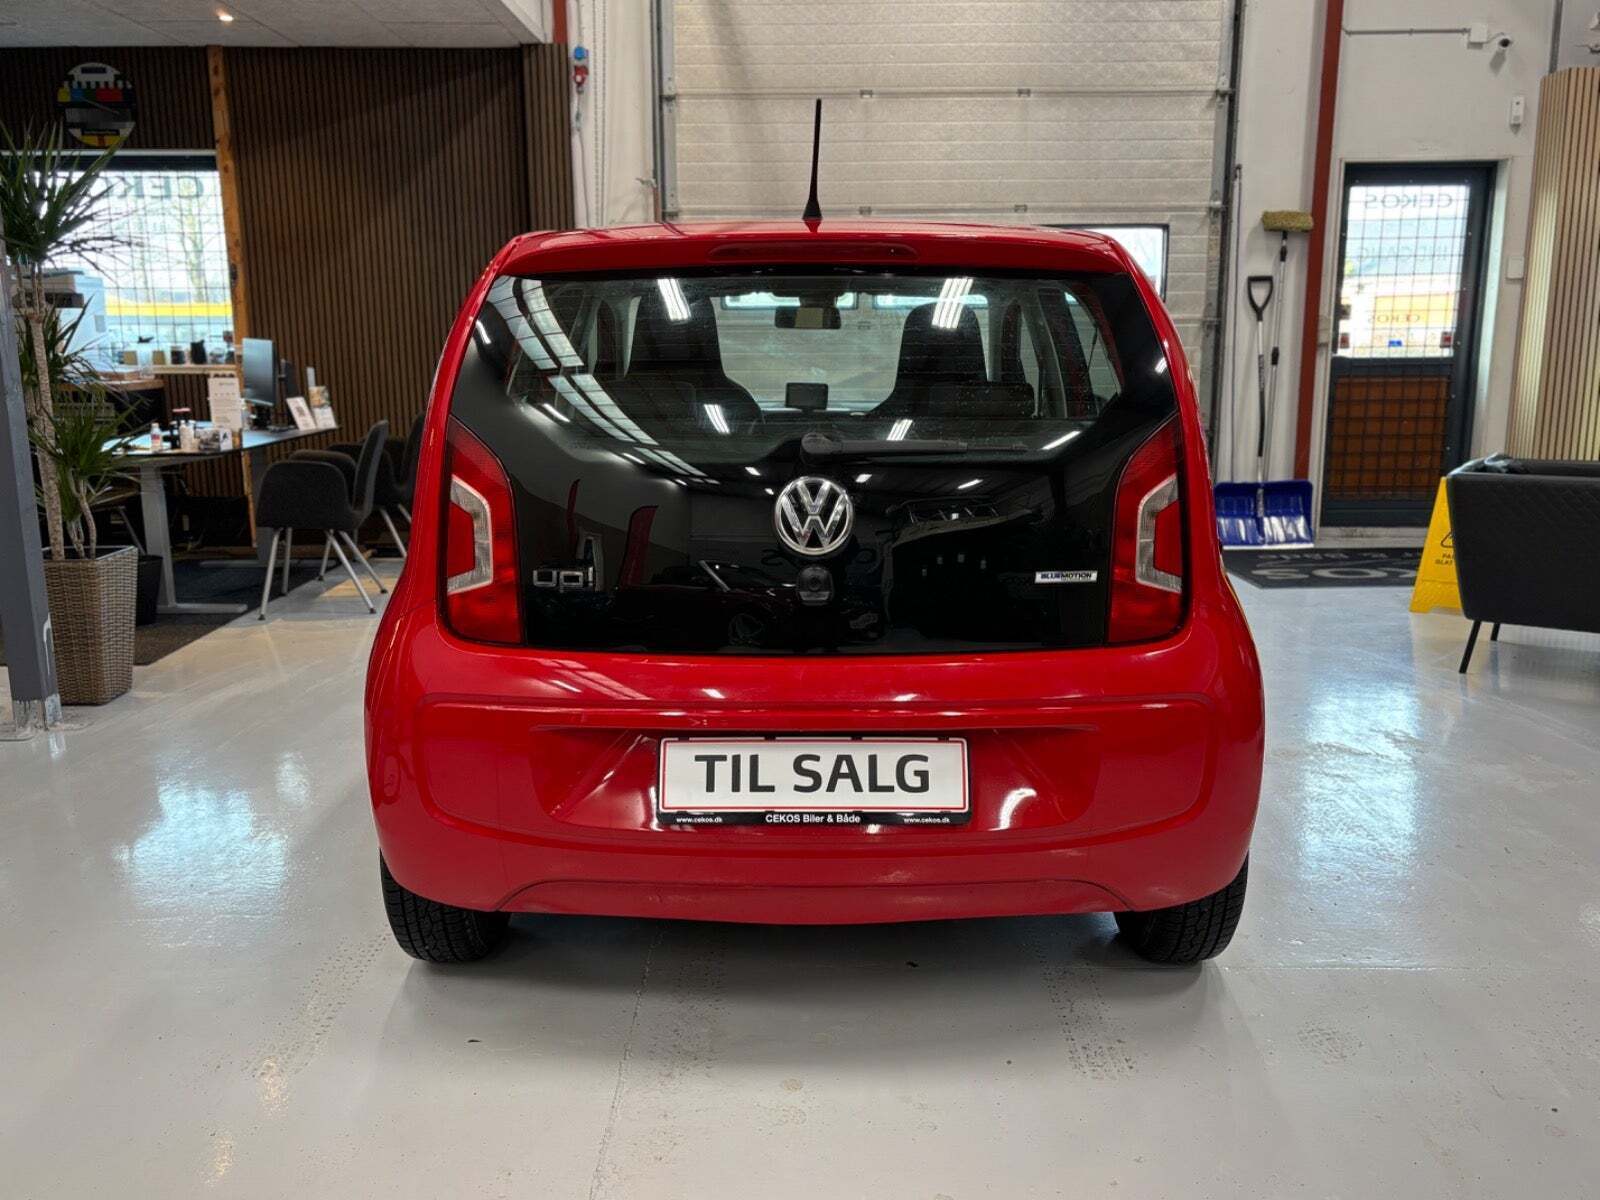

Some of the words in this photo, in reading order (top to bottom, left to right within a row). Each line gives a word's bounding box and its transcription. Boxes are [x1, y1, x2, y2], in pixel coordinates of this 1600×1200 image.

[532, 566, 594, 594] up!
[694, 753, 776, 793] TIL
[792, 753, 930, 794] SALG
[765, 813, 801, 823] CEKOS
[802, 813, 825, 823] Biler
[826, 813, 834, 823] &
[836, 812, 861, 823] Både
